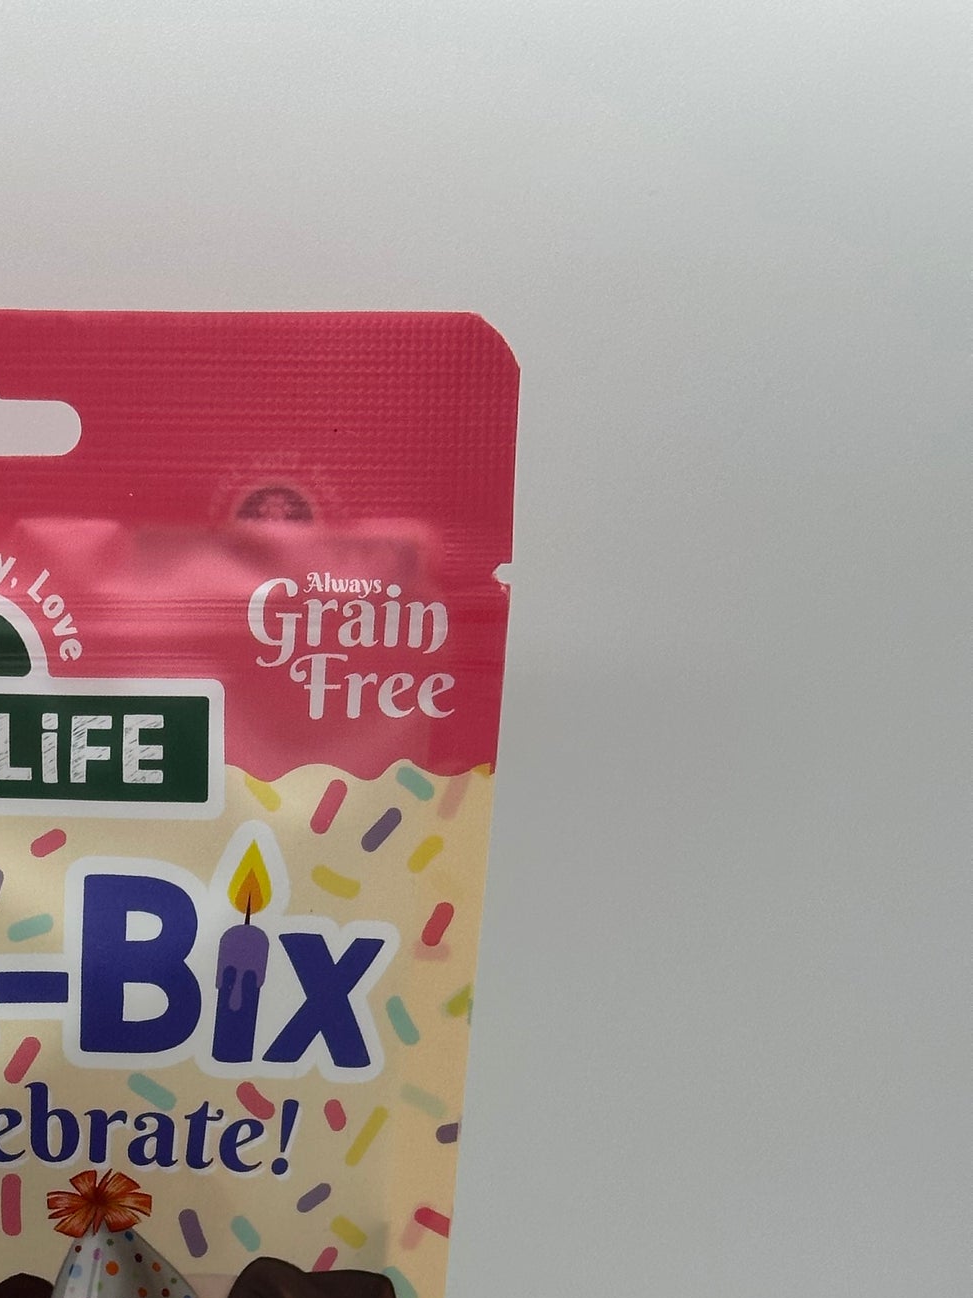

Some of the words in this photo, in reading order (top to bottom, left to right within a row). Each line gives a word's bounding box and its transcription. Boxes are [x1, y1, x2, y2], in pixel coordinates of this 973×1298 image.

[27, 568, 83, 662] Love
[246, 578, 450, 668] Grain
[304, 572, 384, 598] Always
[288, 653, 456, 721] Free
